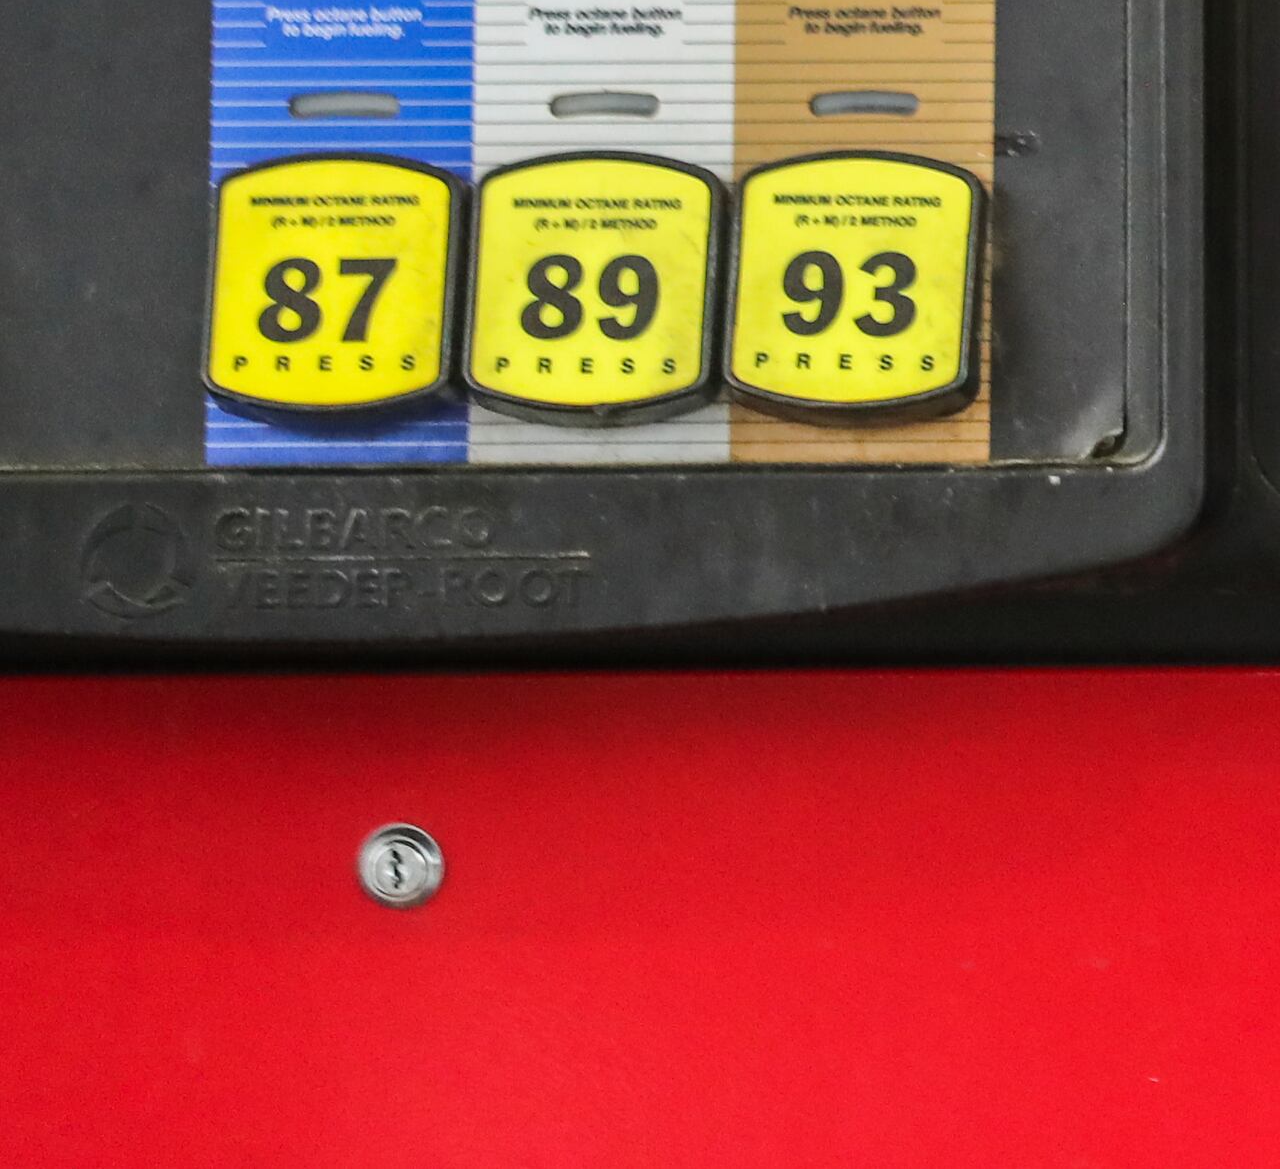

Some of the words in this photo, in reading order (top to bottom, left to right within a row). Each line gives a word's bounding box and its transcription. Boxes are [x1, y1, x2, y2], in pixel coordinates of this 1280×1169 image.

[250, 195, 308, 208] MINIMUM
[313, 195, 368, 208] OCTANE
[371, 196, 420, 208] RATING
[513, 196, 571, 209] MINIMUM
[575, 197, 629, 210] OCTANE
[632, 198, 683, 211] RATING
[773, 193, 833, 206] MINIMUM
[835, 194, 890, 207] OCTANE
[893, 195, 942, 208] RATING
[861, 215, 917, 228] METHOD
[257, 256, 398, 345] 87
[519, 252, 661, 342] 89
[780, 249, 918, 339] 93
[213, 506, 492, 552] GILBARCO
